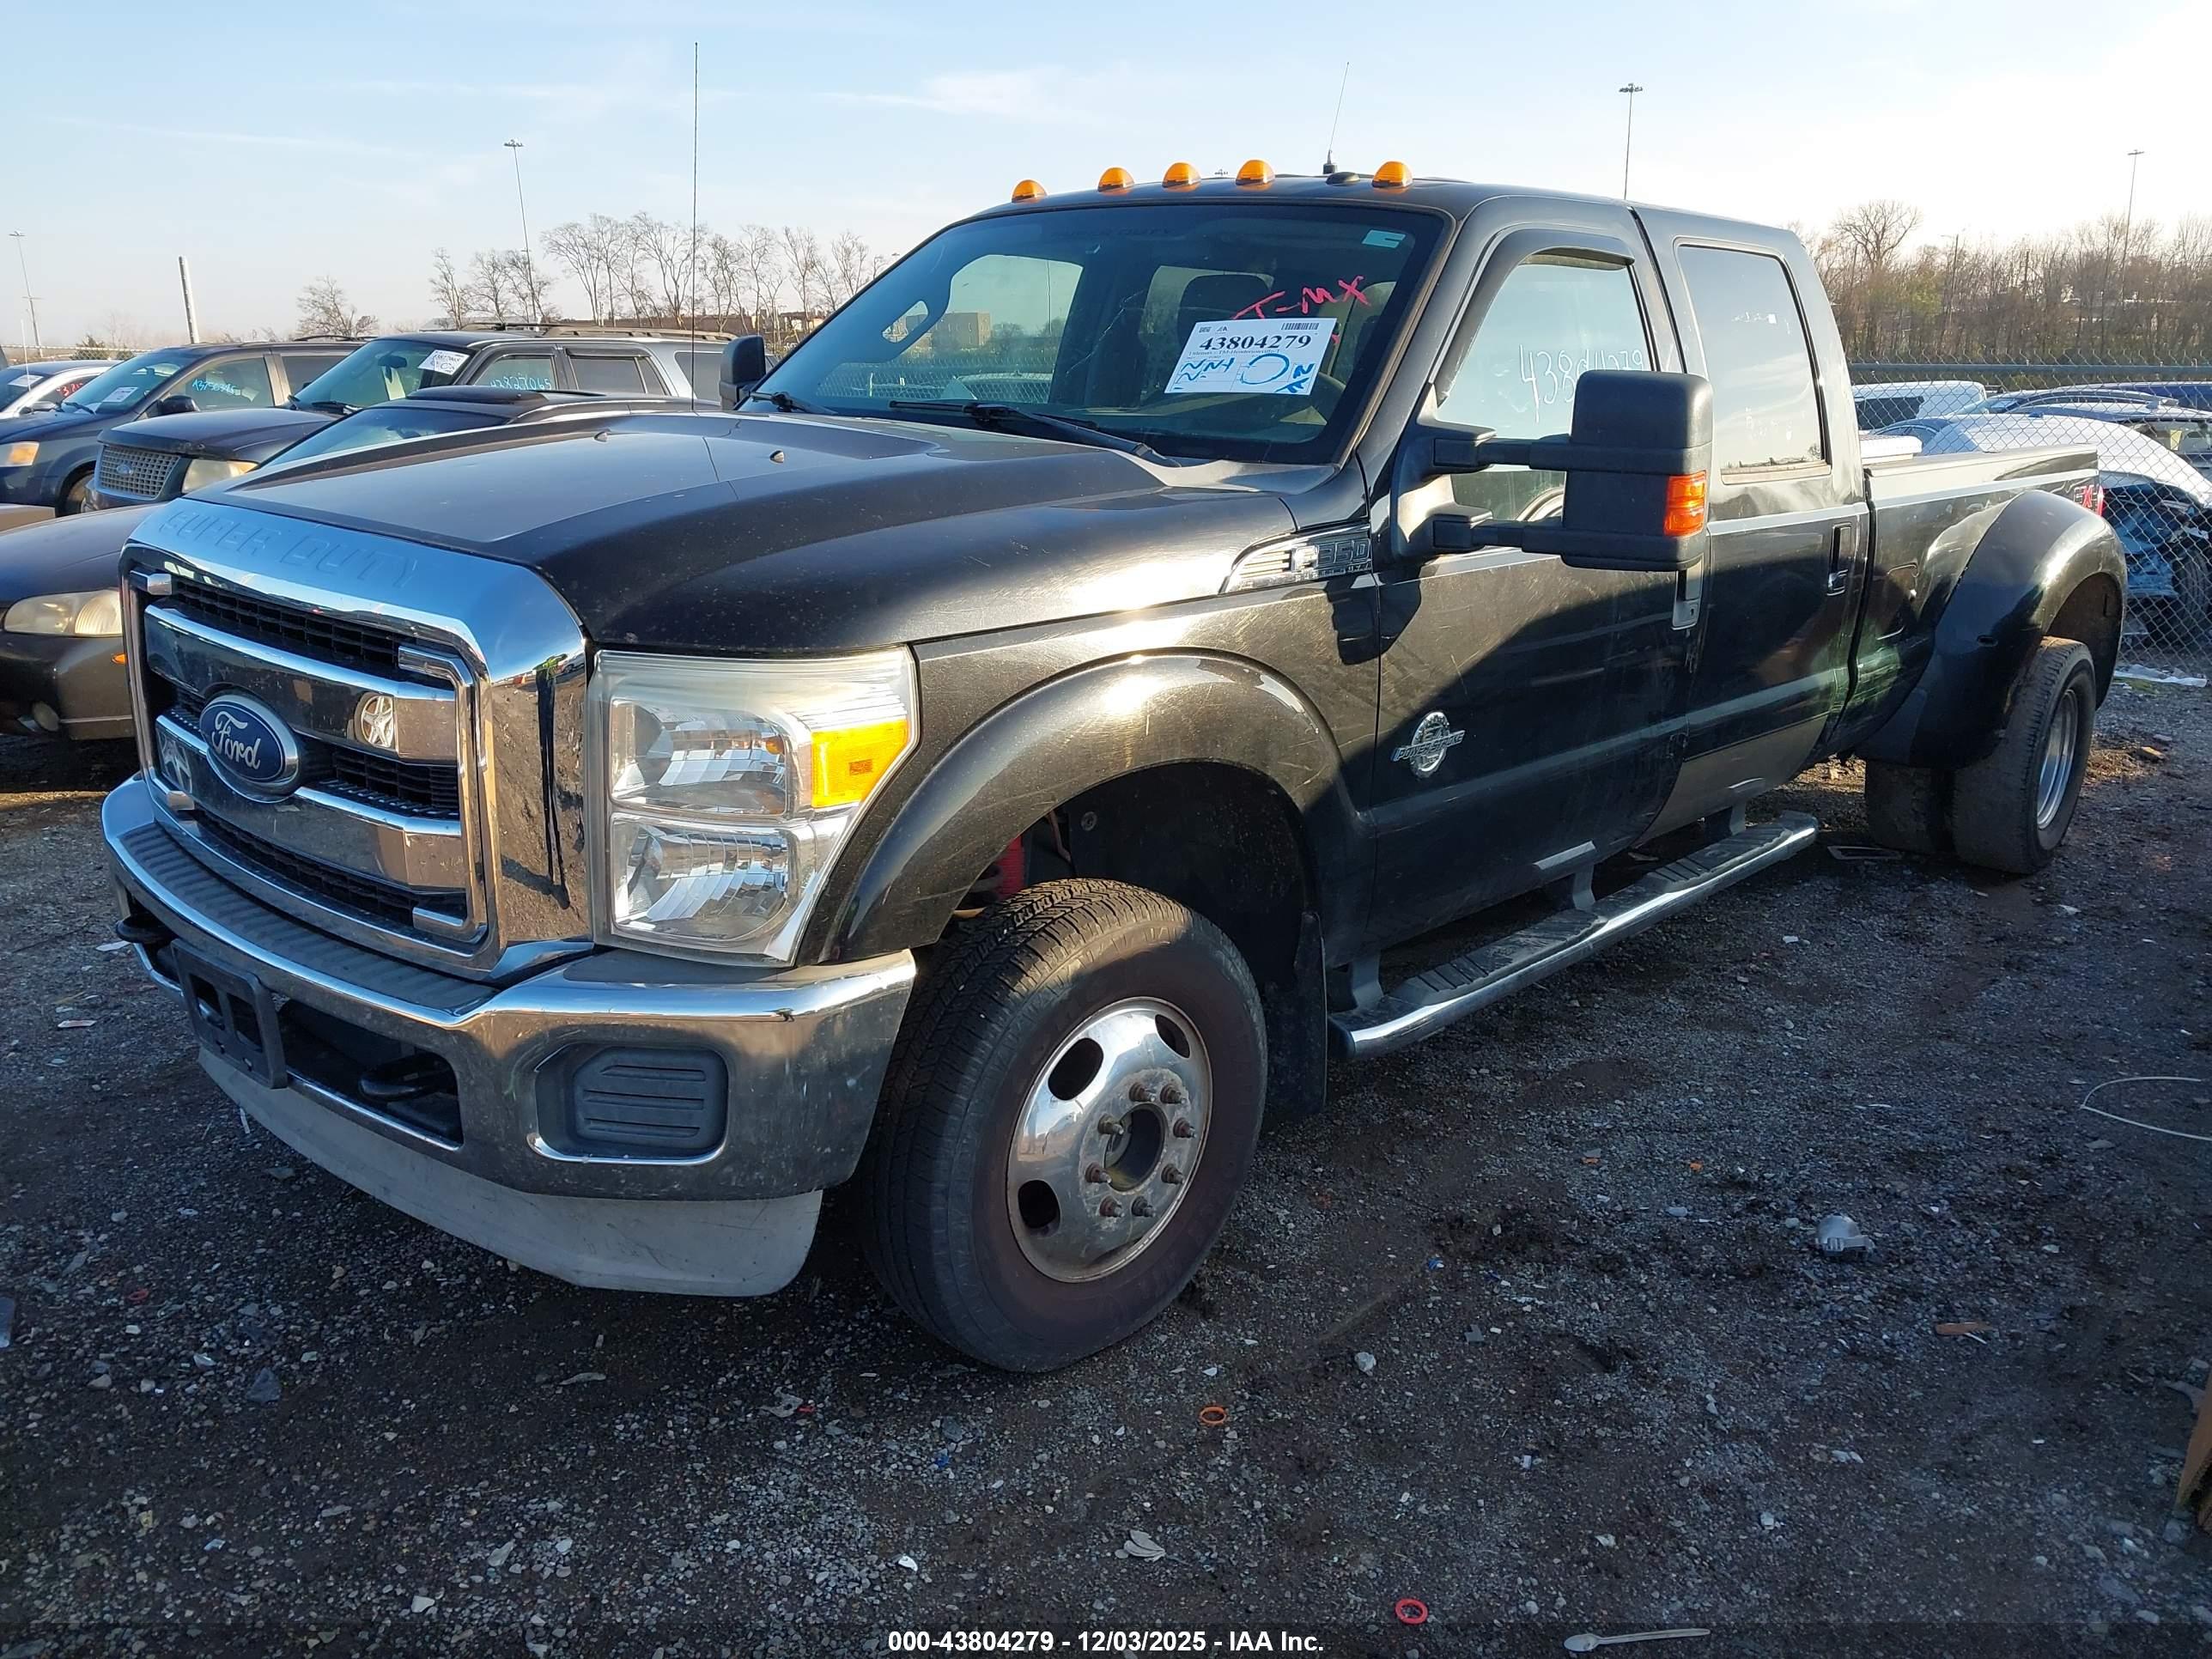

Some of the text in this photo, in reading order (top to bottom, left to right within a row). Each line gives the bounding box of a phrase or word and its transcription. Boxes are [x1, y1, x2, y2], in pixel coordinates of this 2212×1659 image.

[1200, 335, 1312, 350] 43804279
[159, 511, 418, 589] SUPER DUTY
[211, 709, 262, 771] Ford
